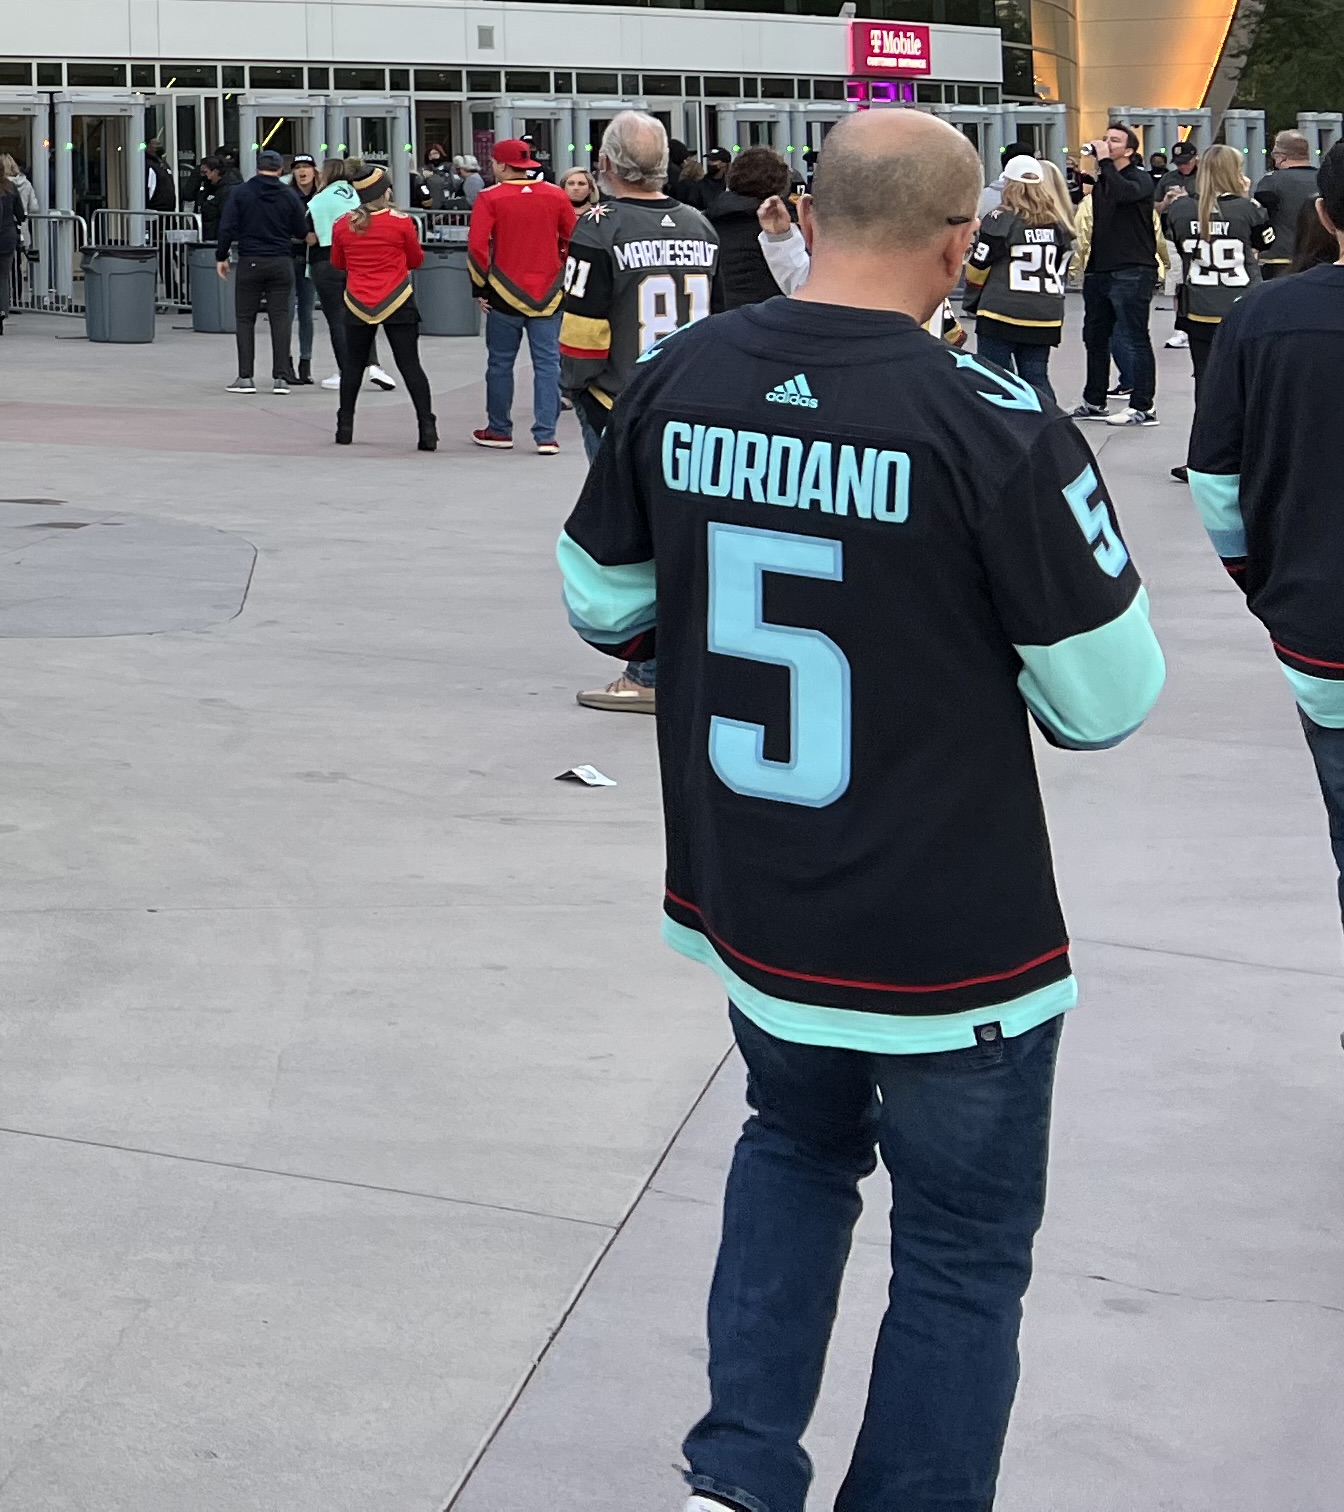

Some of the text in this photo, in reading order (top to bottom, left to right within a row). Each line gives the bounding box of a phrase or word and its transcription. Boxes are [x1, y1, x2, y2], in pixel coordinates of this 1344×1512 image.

[1024, 228, 1056, 244] FLEURY
[1190, 221, 1231, 237] FURY
[613, 239, 719, 271] MARCHESSAUT
[1009, 243, 1066, 294] 29
[1183, 238, 1250, 287] 29
[638, 274, 712, 356] 81
[765, 389, 819, 409] adidas
[661, 420, 910, 524] GIORDANO
[1062, 464, 1129, 579] 5
[708, 521, 852, 809] 5
